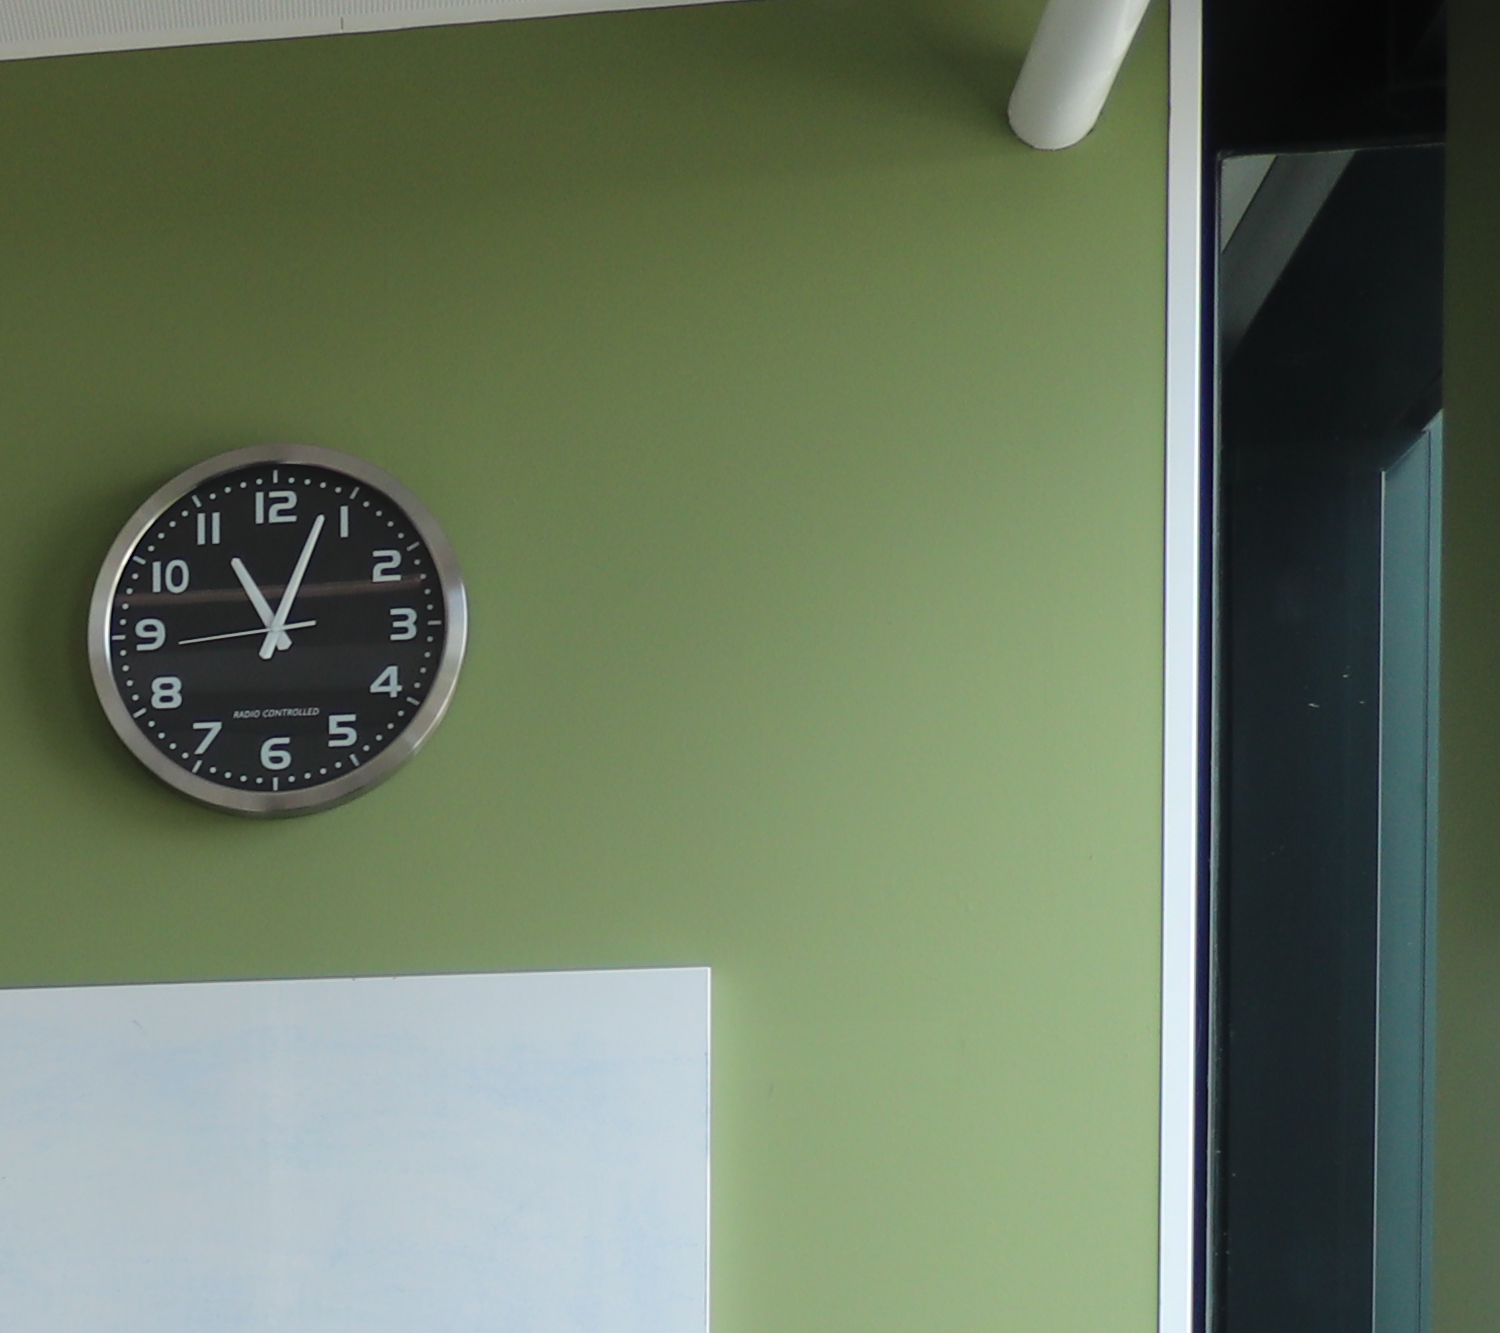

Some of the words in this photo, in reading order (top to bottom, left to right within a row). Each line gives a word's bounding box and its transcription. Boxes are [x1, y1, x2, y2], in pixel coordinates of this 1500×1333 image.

[255, 490, 298, 524] 12
[339, 505, 349, 538] 1
[197, 512, 221, 545] 11
[152, 558, 190, 594] 10
[371, 549, 402, 583] 2
[134, 618, 166, 651] 9
[389, 607, 418, 641] 3
[151, 676, 183, 709] 8
[369, 665, 403, 698] 4
[232, 709, 261, 719] RADIO
[261, 707, 320, 719] CONTROLLED
[327, 713, 358, 747] 5
[192, 721, 223, 755] 7
[260, 736, 292, 770] 6
